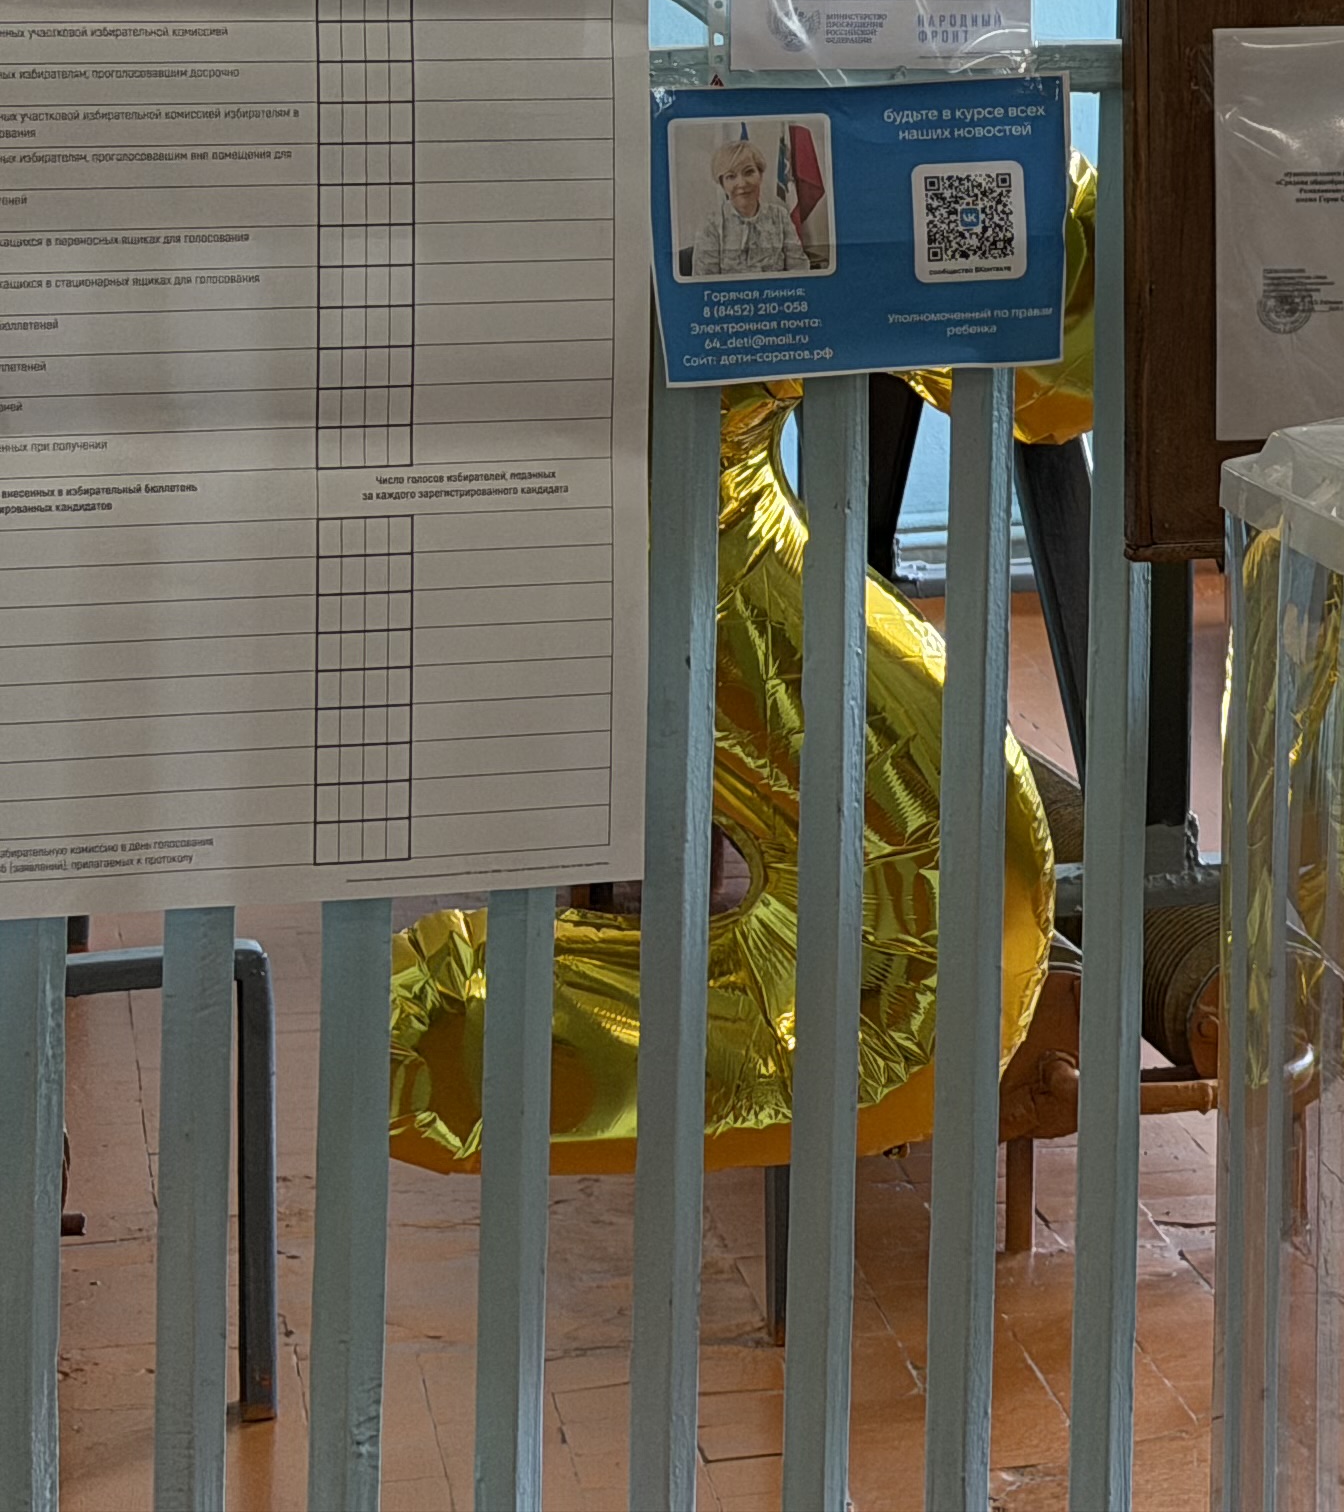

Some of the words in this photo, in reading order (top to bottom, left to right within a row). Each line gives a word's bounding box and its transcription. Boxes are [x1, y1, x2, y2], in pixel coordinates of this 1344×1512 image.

[917, 11, 1002, 28] НАРОДНЫЙ
[918, 29, 968, 44] ФРОНТ
[883, 108, 938, 125] будьте
[942, 109, 952, 120] в
[955, 107, 1004, 122] курсе
[1008, 105, 1046, 118] всех
[899, 126, 951, 140] наших
[954, 122, 1032, 138] новостей
[703, 290, 760, 304] Горячая
[703, 306, 711, 318] 8
[714, 304, 755, 319] (8452)
[757, 301, 808, 316] 210-058
[690, 319, 778, 335] Электронная
